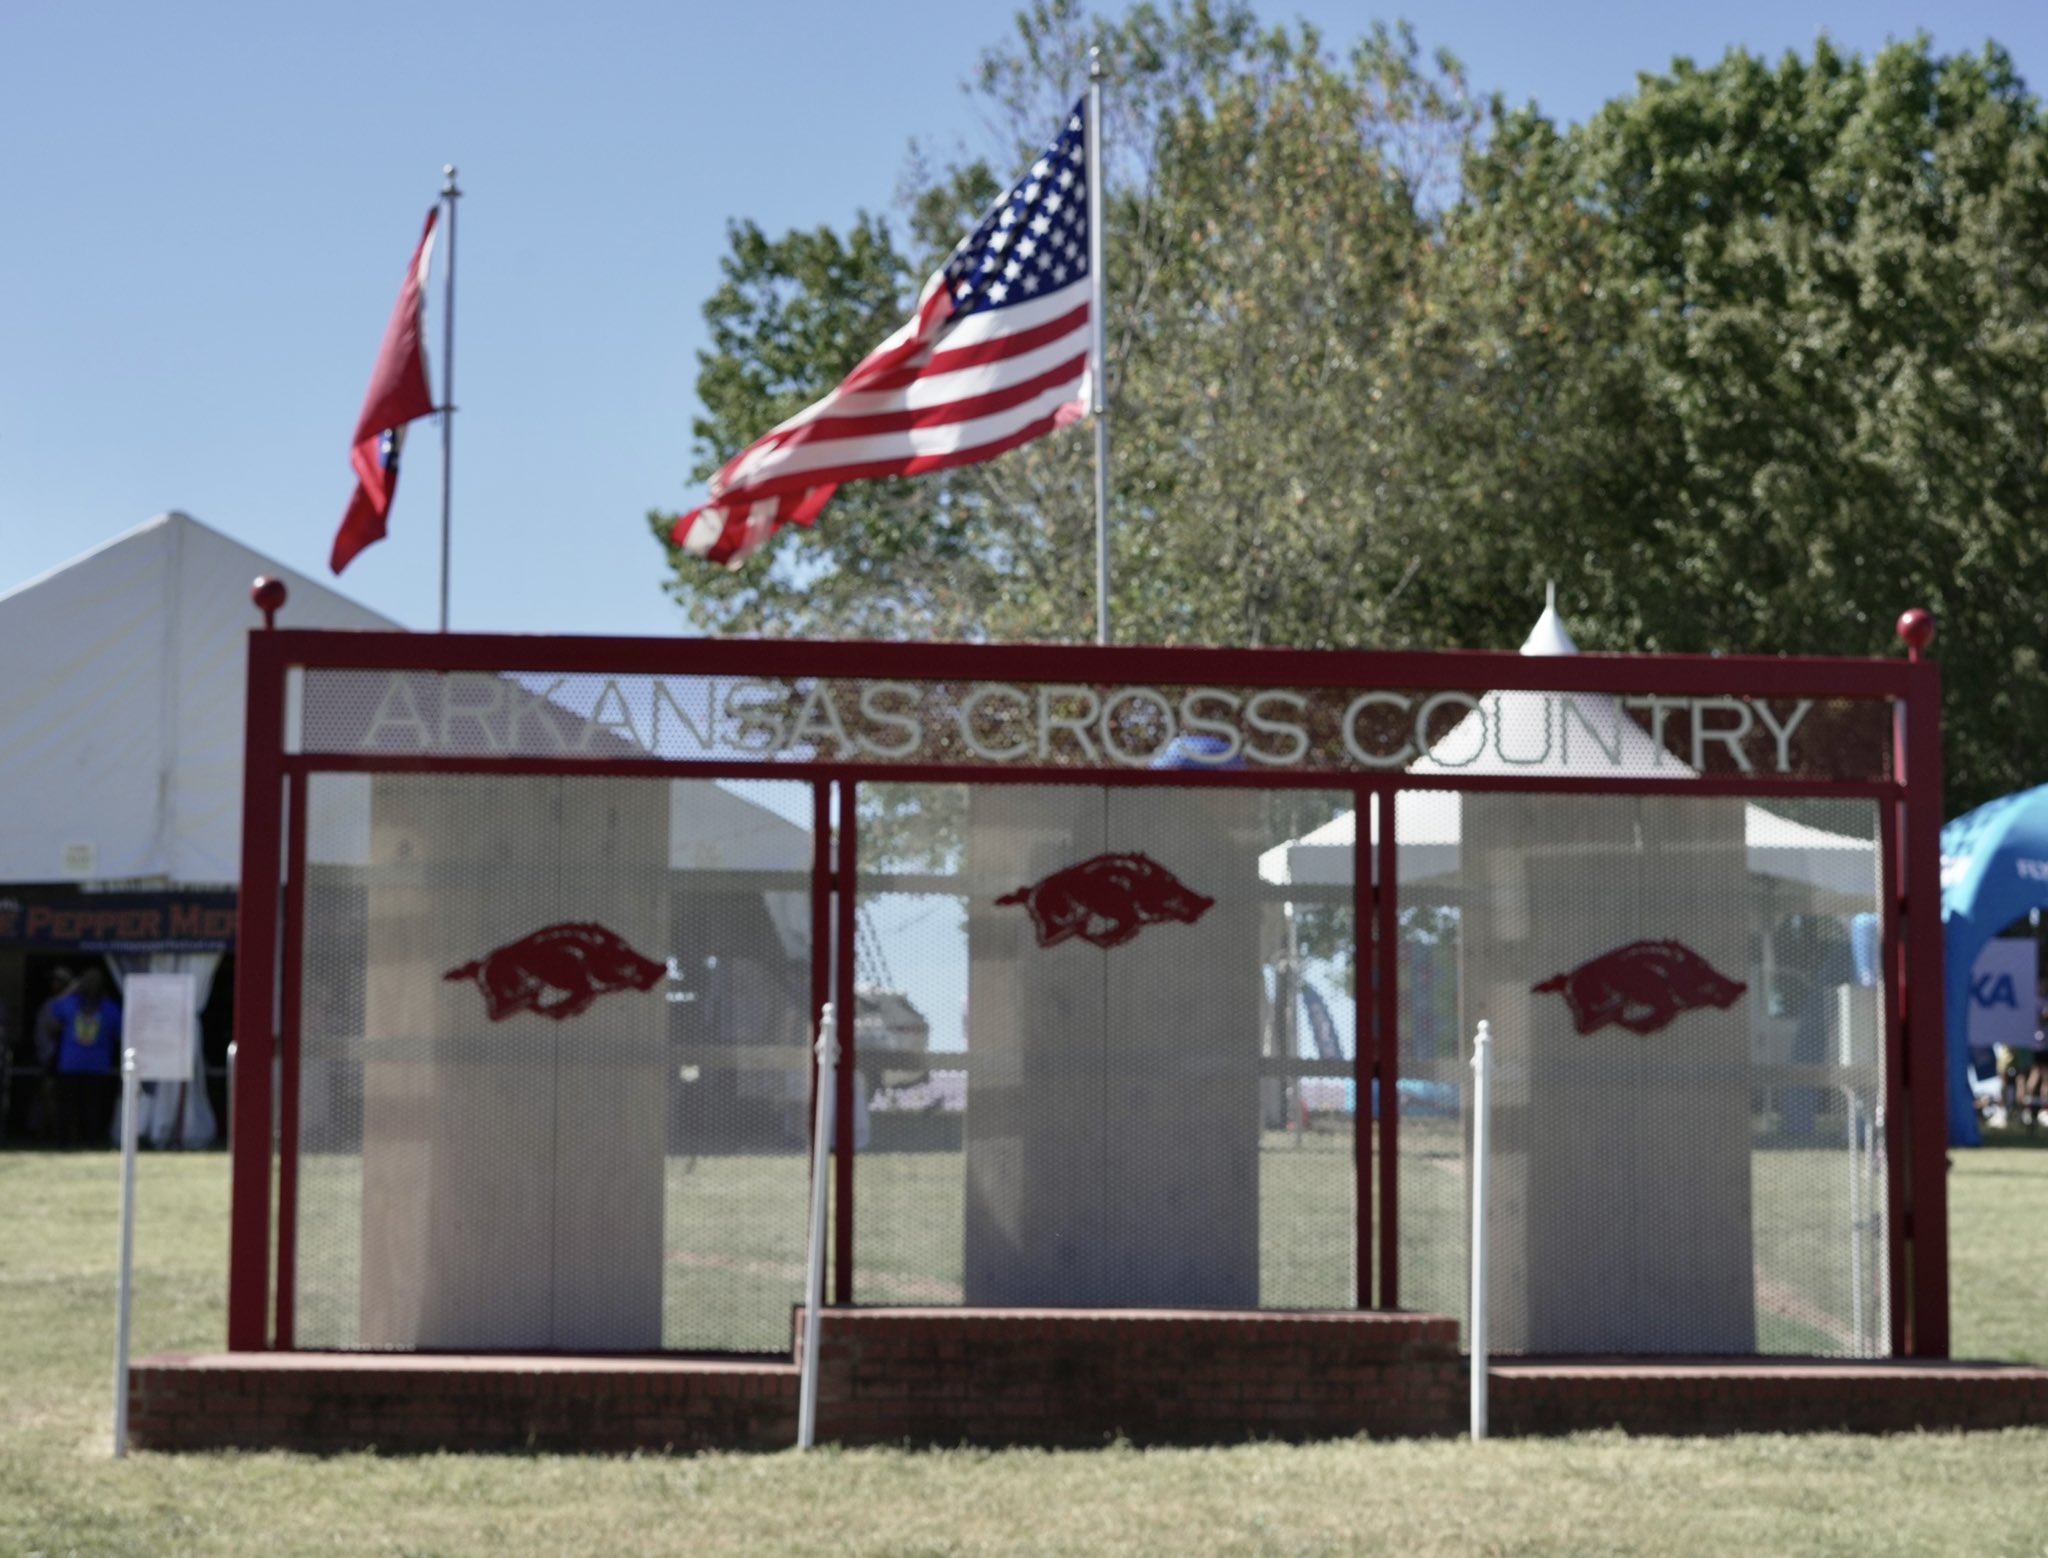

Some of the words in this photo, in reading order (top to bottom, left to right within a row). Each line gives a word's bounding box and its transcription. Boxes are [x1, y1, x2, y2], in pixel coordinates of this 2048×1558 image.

[362, 673, 924, 759] ARKANSAS
[961, 685, 1309, 766] CROSS
[1341, 690, 1815, 773] COUNTRY
